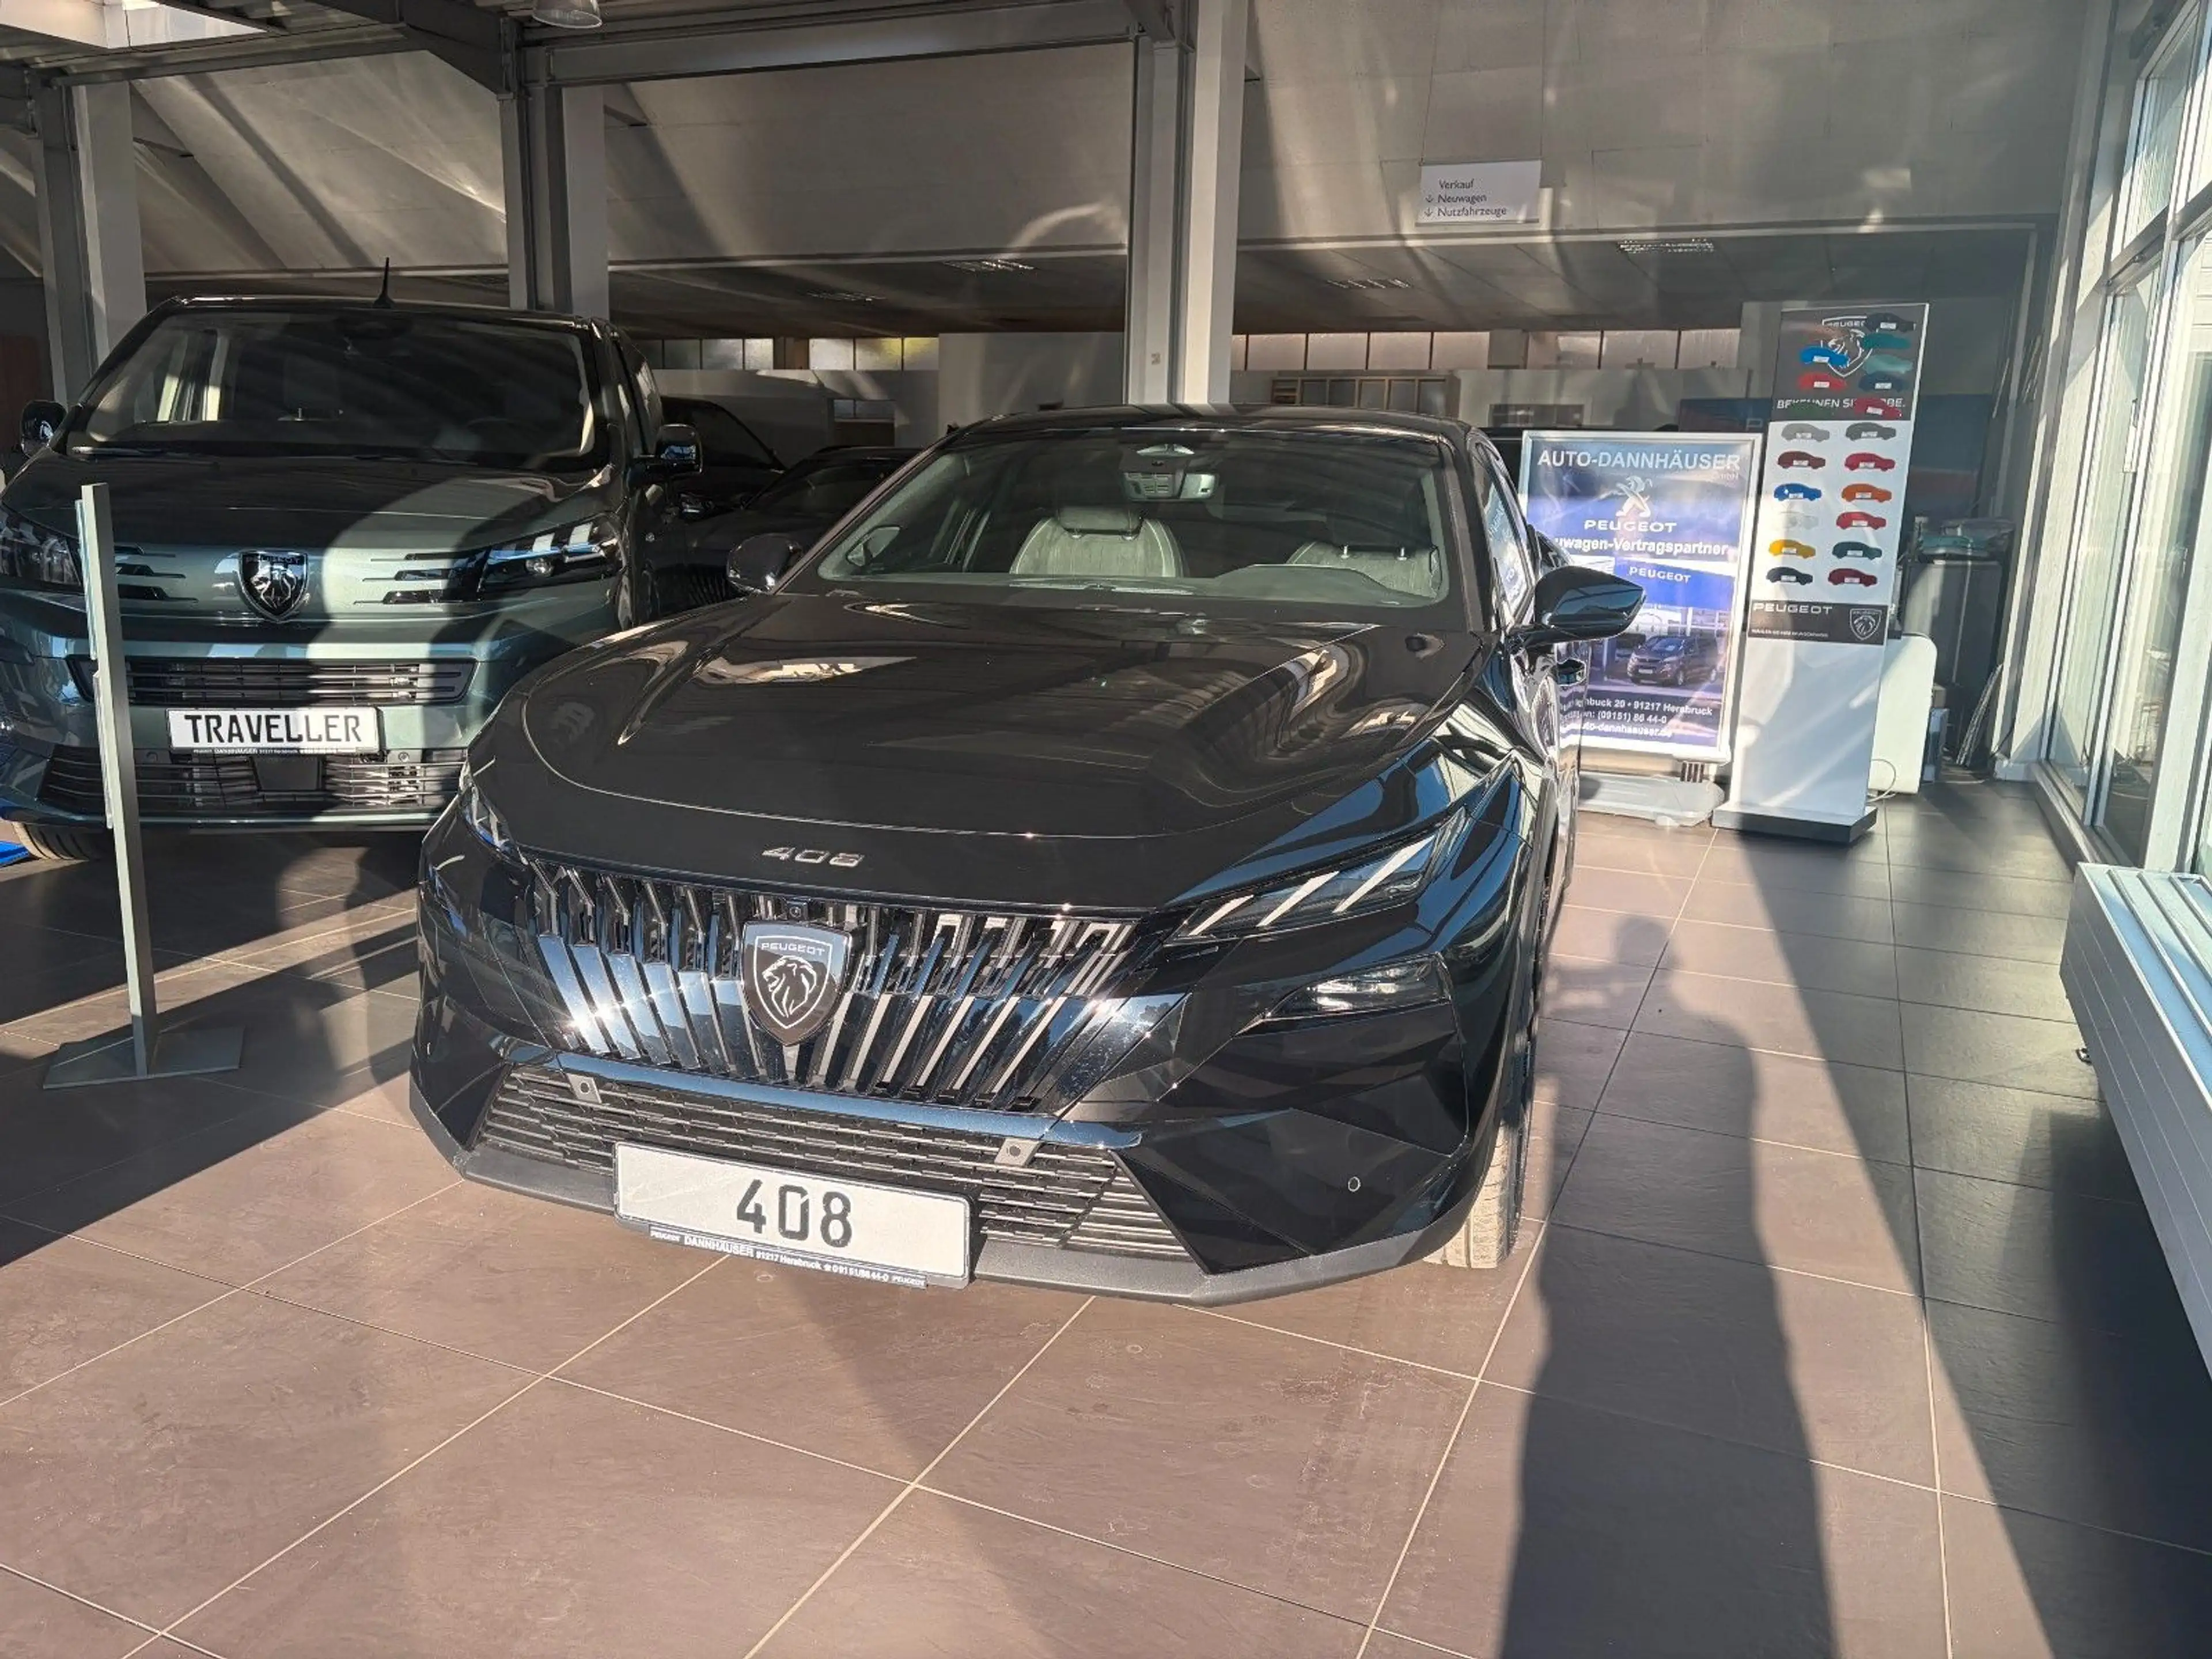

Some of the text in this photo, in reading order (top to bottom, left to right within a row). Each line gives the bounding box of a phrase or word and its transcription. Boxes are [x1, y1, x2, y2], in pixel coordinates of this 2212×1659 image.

[1439, 179, 1474, 190] Verkauf
[1437, 194, 1487, 206] Neuwagen
[1437, 206, 1507, 217] Nutzfahrzeuge
[1537, 449, 1741, 470] AUTO-DANNHÄUSER
[1584, 520, 1677, 533] PEUGEOT
[1628, 566, 1692, 583] PEUGEOT
[1752, 602, 1833, 616] PEUGEOT
[1634, 700, 1661, 711] 91217
[1663, 703, 1713, 716] Hersbruck
[184, 714, 362, 744] TRAVELLER
[762, 847, 865, 868] 408
[760, 942, 825, 956] PEUGEOT
[736, 1179, 853, 1248] 408
